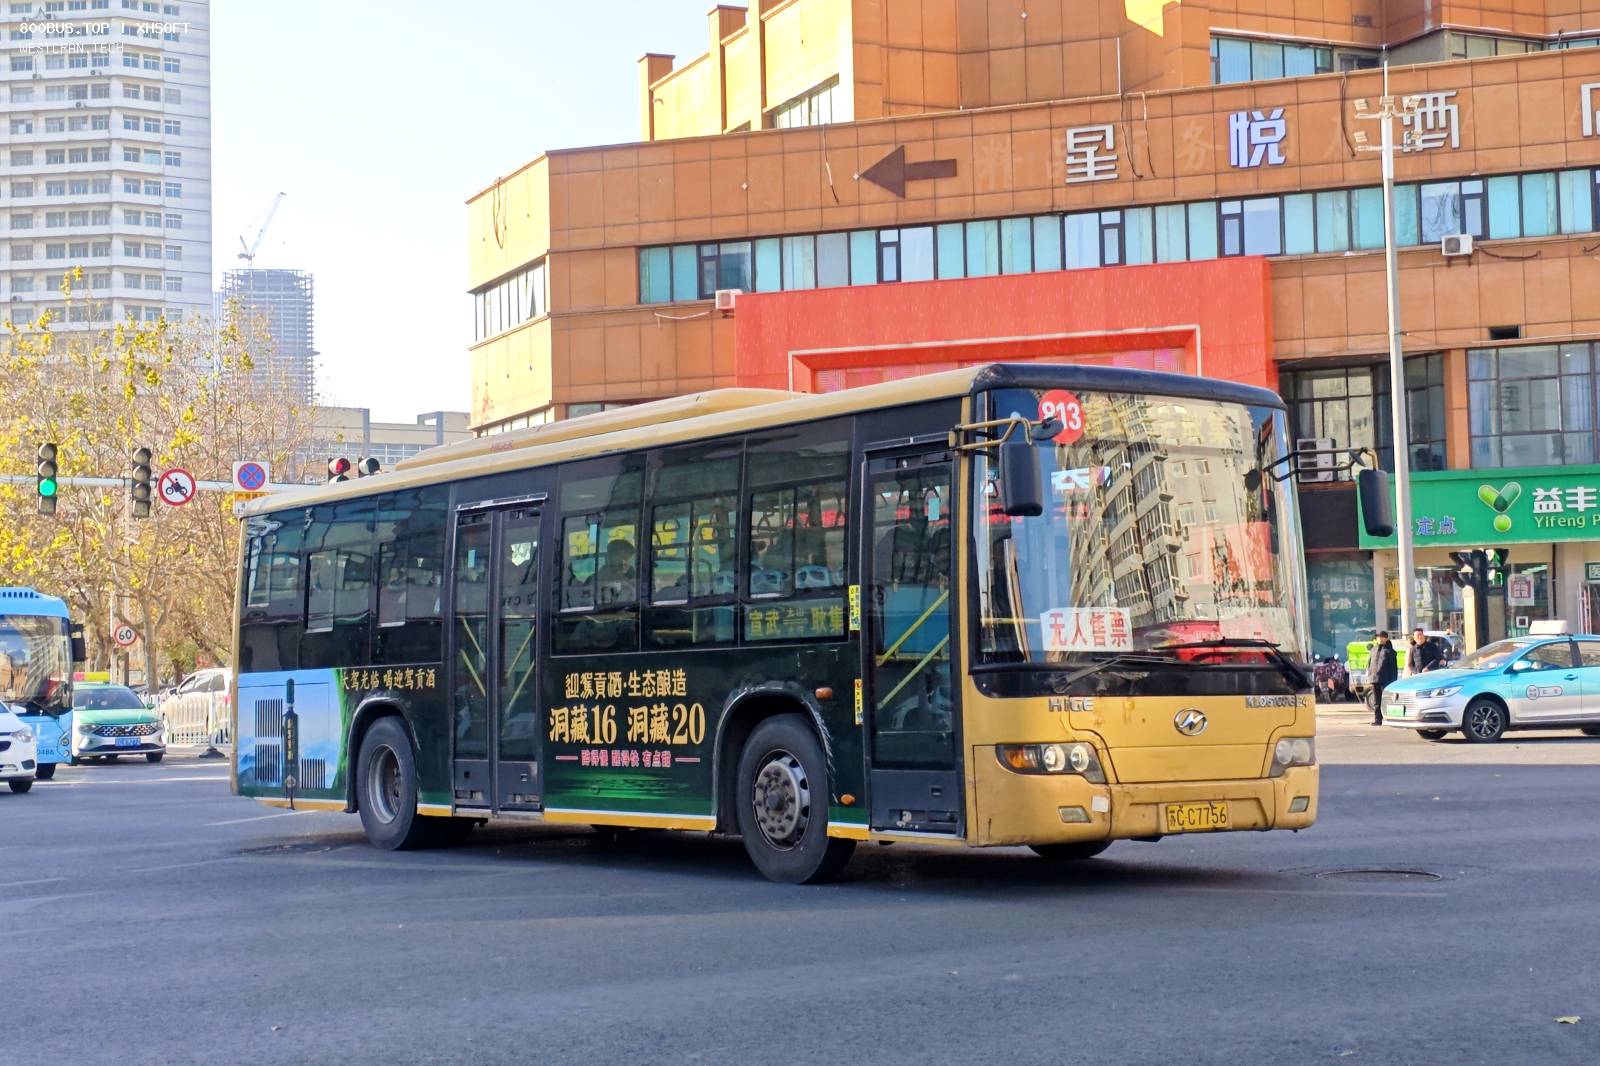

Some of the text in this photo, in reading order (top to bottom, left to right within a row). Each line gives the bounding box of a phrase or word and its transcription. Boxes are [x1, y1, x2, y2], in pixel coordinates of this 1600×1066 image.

[1532, 486, 1598, 513] 益丰
[1534, 516, 1586, 528] Yifeng
[119, 629, 132, 640] 60
[1049, 611, 1128, 647] 无人售票
[549, 703, 706, 745] 洞藏16 洞藏20
